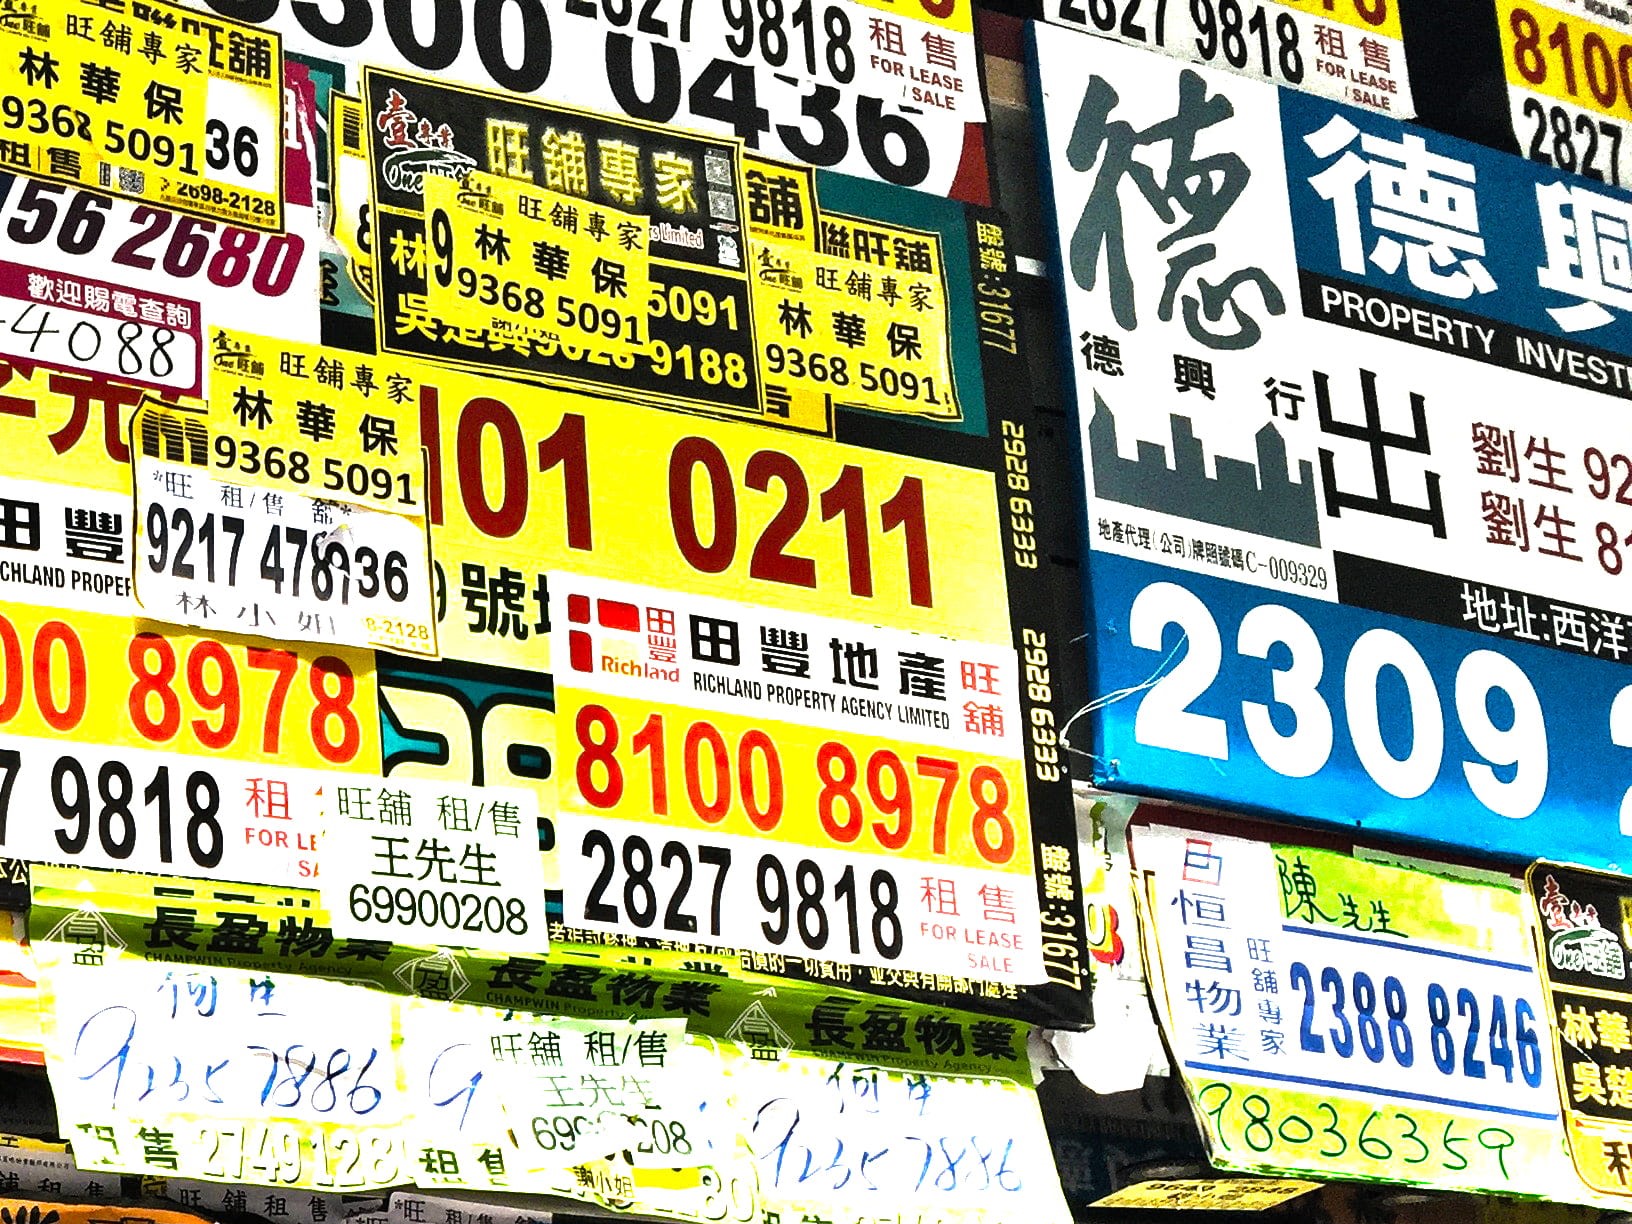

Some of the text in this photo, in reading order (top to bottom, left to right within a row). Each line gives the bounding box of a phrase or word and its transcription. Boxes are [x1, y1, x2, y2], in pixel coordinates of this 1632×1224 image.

[66, 13, 209, 76] 旺舖專家
[869, 54, 906, 78] FOR
[1193, 2, 1306, 86] 9818
[1315, 56, 1398, 95] FOR LEASE
[18, 46, 185, 127] 林華保
[911, 86, 957, 112] SALE
[1352, 85, 1391, 110] SALE
[103, 122, 200, 177] 5091
[518, 193, 649, 254] 旺舖專家
[474, 223, 630, 301] 林華保
[814, 264, 936, 313] 旺舖專家
[456, 265, 643, 347] 9368 5091
[776, 299, 925, 362] 林華保
[1320, 289, 1496, 356] PROPERTY
[278, 348, 416, 405] 旺舖專家
[649, 338, 748, 390] 9188
[765, 342, 939, 406] 9368 5091
[231, 386, 401, 458] 林華保
[213, 434, 419, 505] 9368 5091
[1470, 423, 1573, 495] 劉生
[145, 501, 245, 588] 9217
[667, 434, 936, 609] 0211
[689, 612, 947, 701] 田豐地產
[127, 632, 362, 766] 8978
[692, 671, 950, 731] RICHLAND PROPERTY AGENCY LIMITED
[959, 660, 1007, 739] 旺舖
[1127, 580, 1551, 820] 2309
[48, 755, 226, 870] 9818
[436, 792, 522, 841] 租/售
[574, 704, 1016, 866] 8100 8978
[370, 835, 502, 889] 王先生
[579, 828, 905, 961] 2827 9818
[348, 884, 530, 936] 69900208
[918, 921, 1025, 952] FOR LEASE
[967, 951, 1015, 975] SALE
[1289, 961, 1544, 1090] 2388 8246
[1197, 1081, 1516, 1182] 98036359
